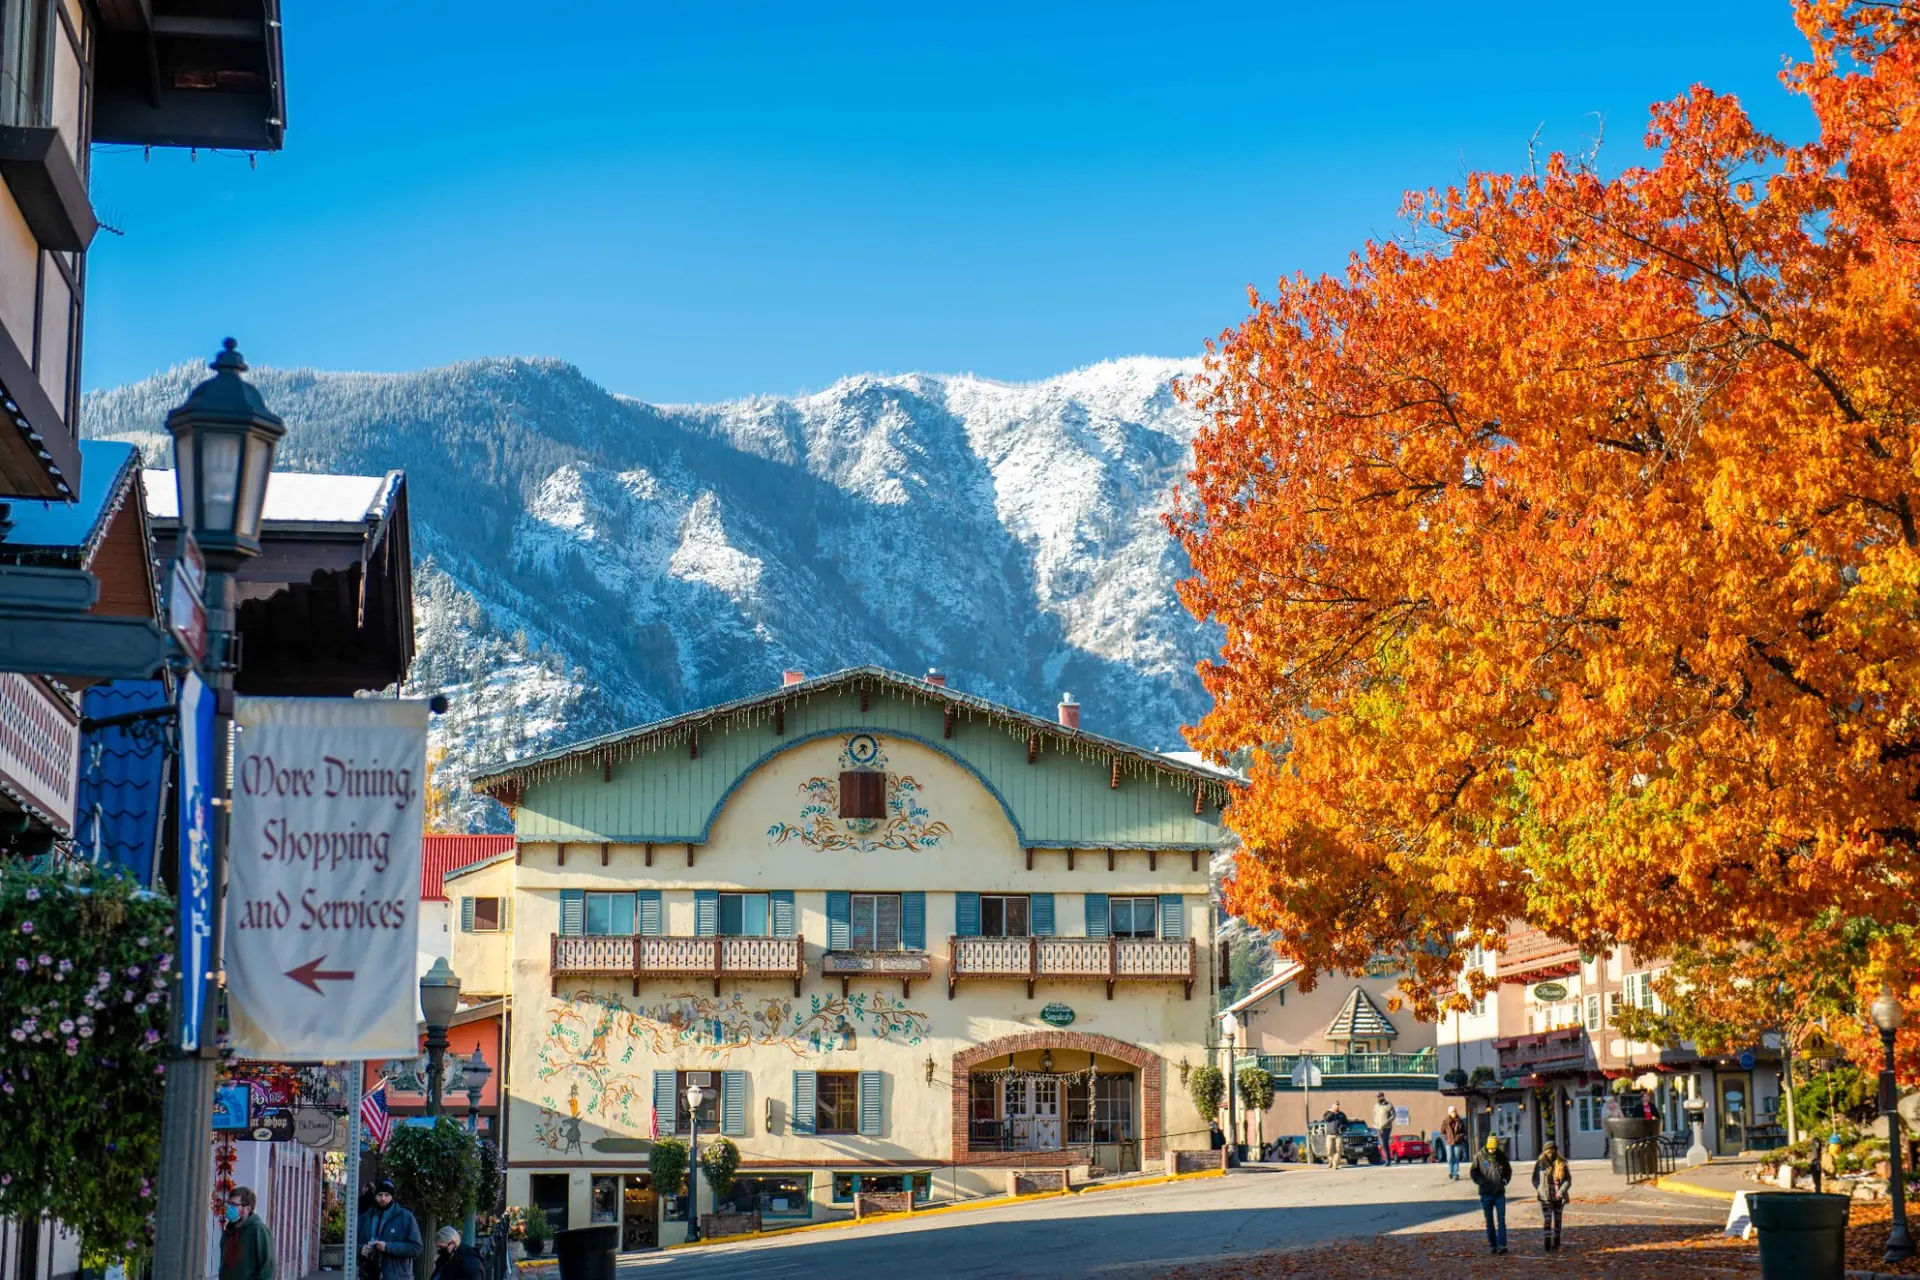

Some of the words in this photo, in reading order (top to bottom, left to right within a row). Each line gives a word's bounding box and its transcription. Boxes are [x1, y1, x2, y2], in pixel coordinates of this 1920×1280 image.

[241, 755, 315, 797] More
[261, 818, 392, 873] Shopping
[239, 890, 291, 931] and
[300, 888, 406, 931] Services
[263, 1116, 288, 1128] Shop
